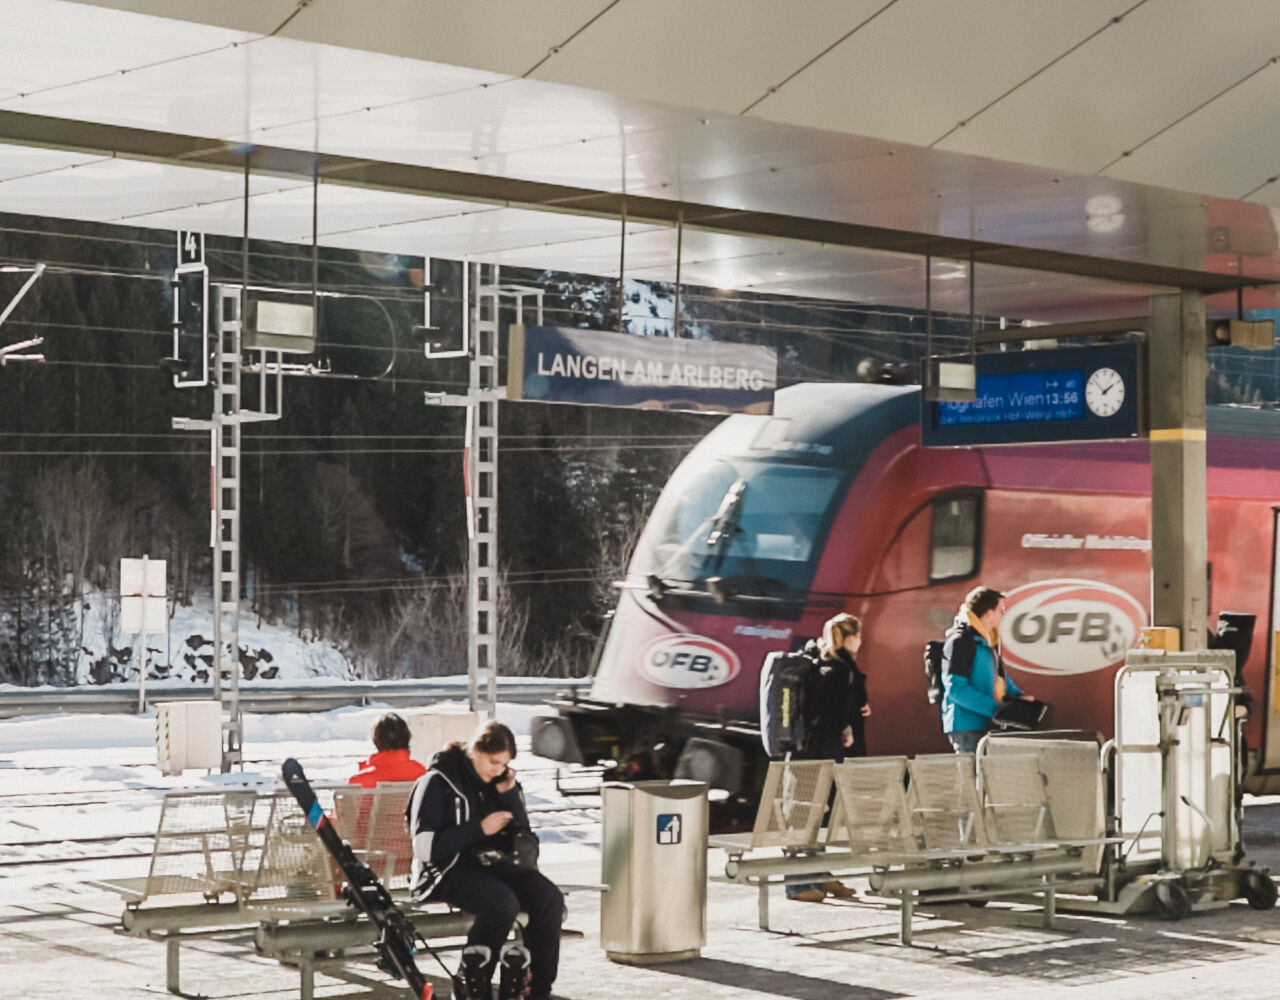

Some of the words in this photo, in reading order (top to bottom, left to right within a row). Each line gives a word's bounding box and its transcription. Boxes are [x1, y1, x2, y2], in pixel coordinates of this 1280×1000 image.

[184, 230, 197, 260] 4
[537, 352, 625, 381] LANGEN
[633, 361, 663, 384] AM
[667, 363, 764, 392] ARLBERG
[1008, 391, 1044, 407] Wien
[1045, 391, 1078, 405] 13:56
